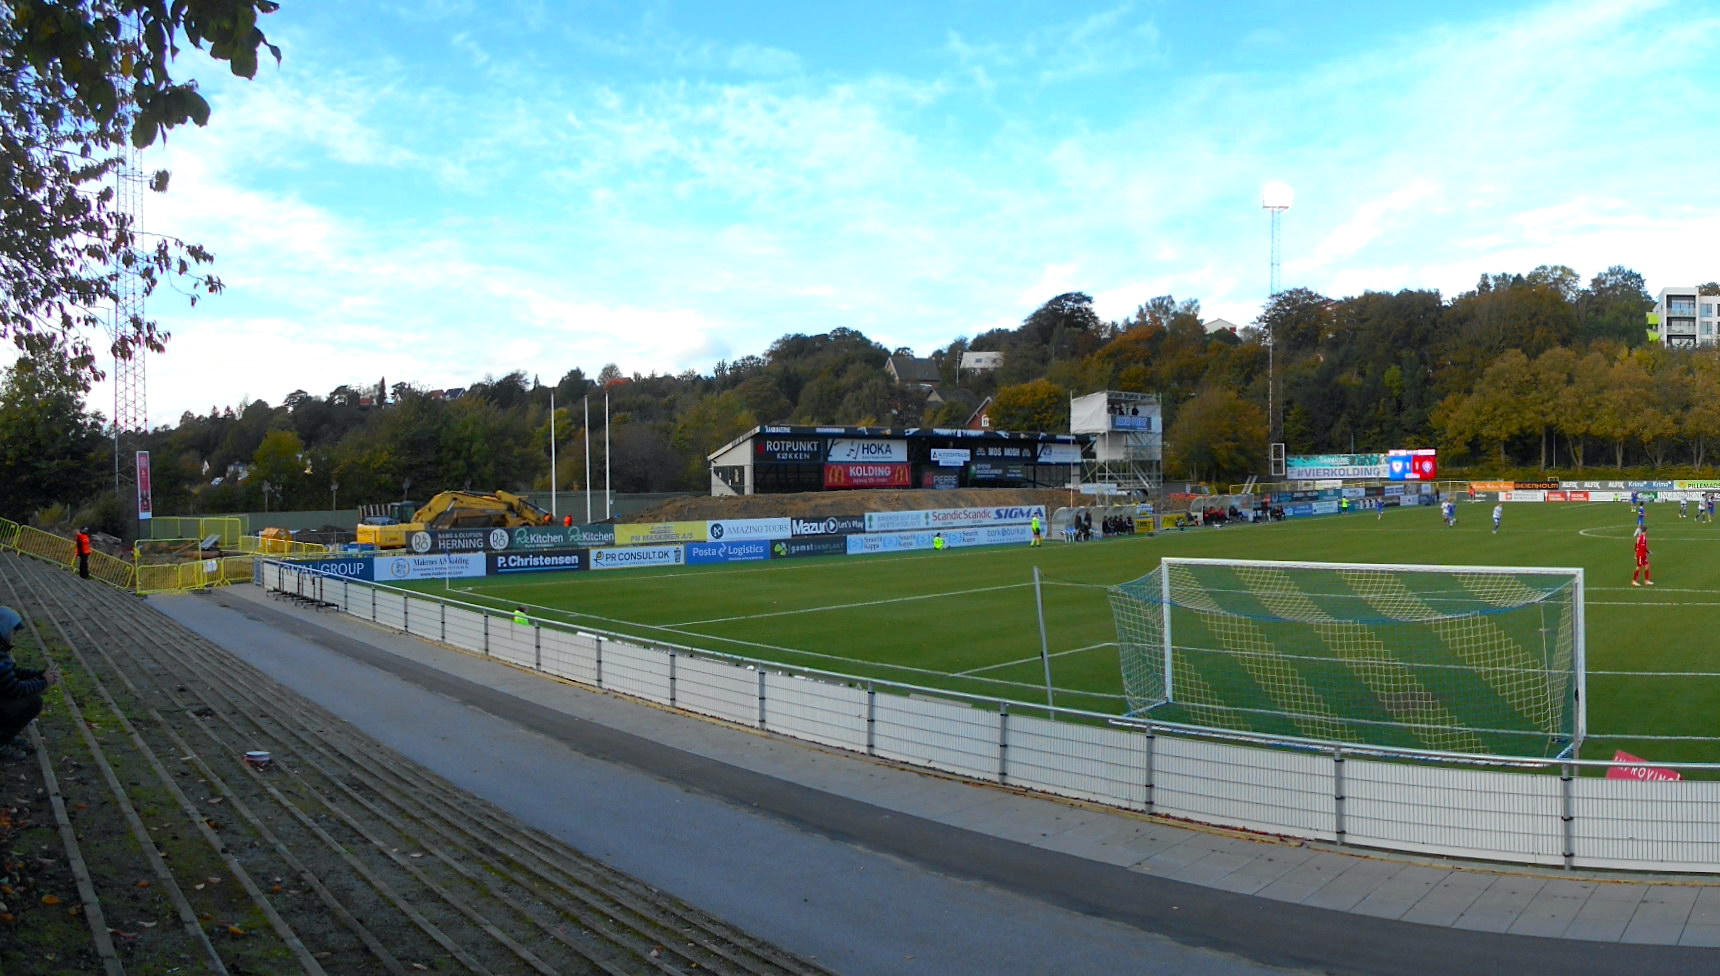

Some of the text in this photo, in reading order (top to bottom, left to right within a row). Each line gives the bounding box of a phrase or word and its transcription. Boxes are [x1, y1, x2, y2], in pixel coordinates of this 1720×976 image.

[766, 440, 818, 452] ROTPUNKT
[862, 443, 892, 454] HOKA
[850, 466, 891, 476] KOLDING
[1298, 466, 1380, 478] #VIERKOLDING
[932, 512, 962, 520] Scandic
[963, 510, 991, 519] Scandic
[994, 508, 1045, 520] SIGMA
[727, 524, 788, 534] AMAZING TOURS
[438, 538, 484, 549] HERNING
[692, 544, 764, 556] Posta Logistics
[498, 554, 578, 567] P. Christensen
[606, 553, 617, 562] PR
[320, 562, 364, 576] GROUP
